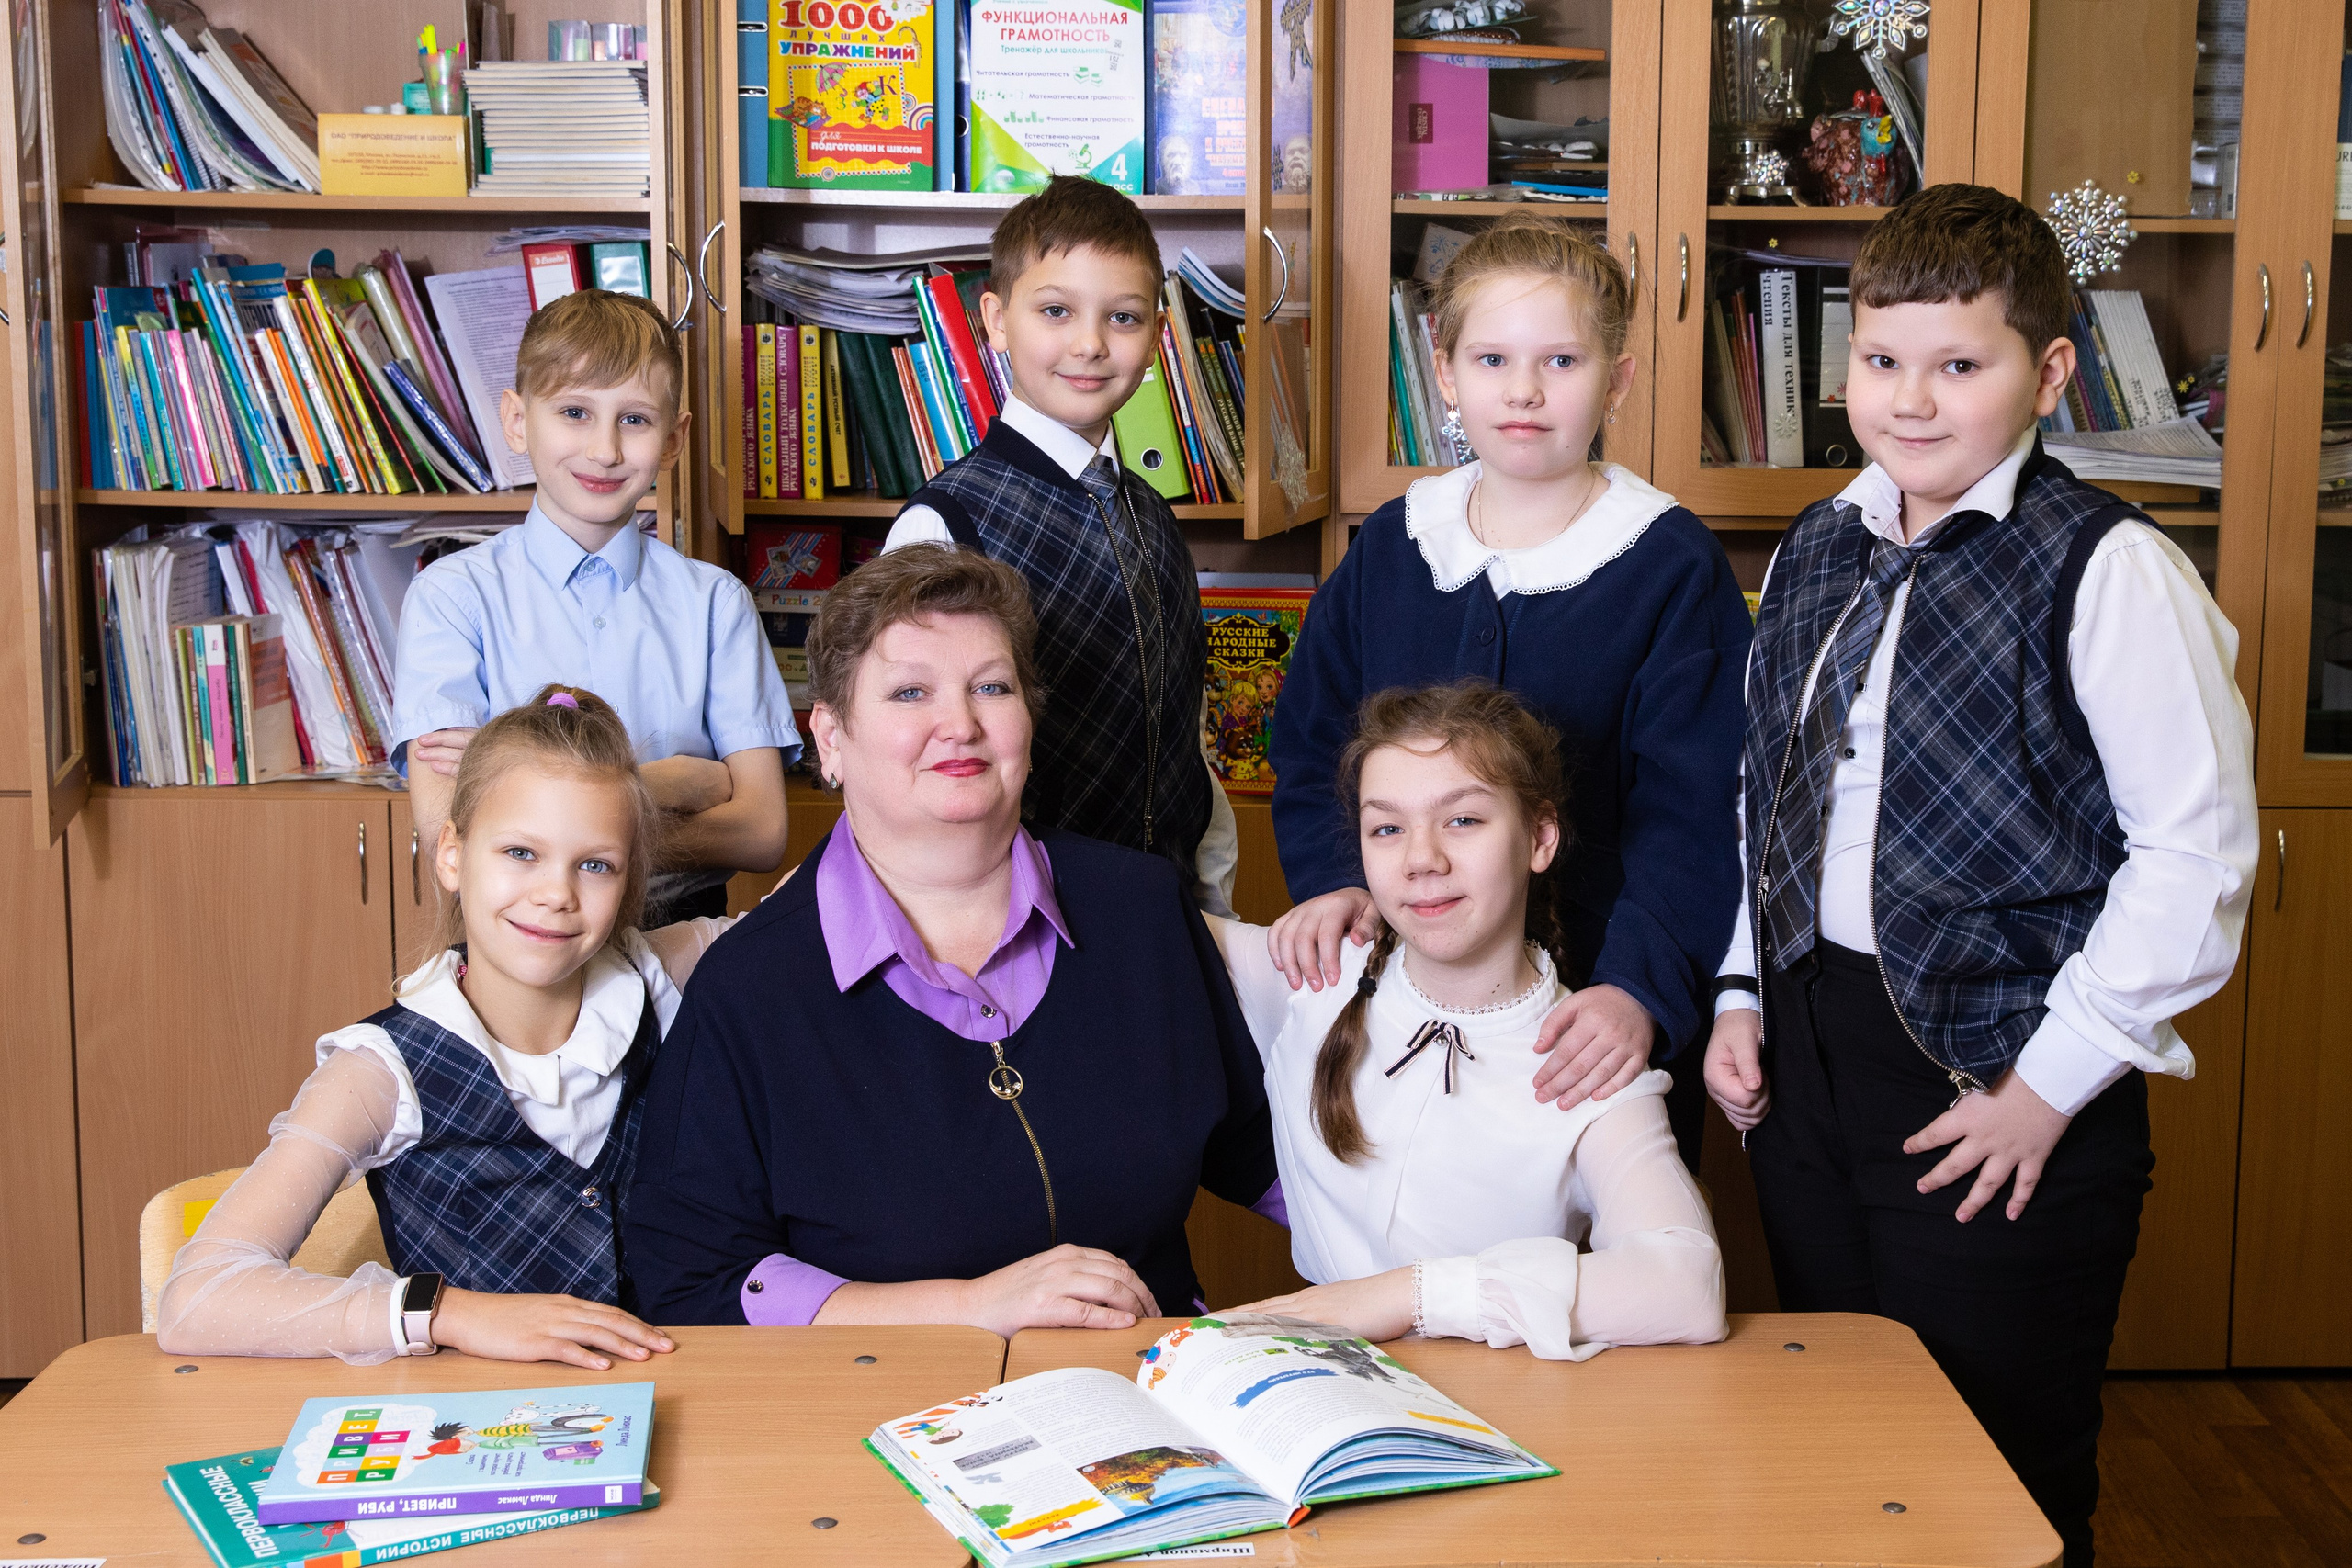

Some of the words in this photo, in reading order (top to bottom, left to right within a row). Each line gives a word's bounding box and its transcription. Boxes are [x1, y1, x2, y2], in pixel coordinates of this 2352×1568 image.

[780, 2, 895, 33] 1000
[981, 10, 1128, 25] ФУНКЦИОНАЛЬНАЯ
[1001, 28, 1110, 42] ГРАМОТНОСТЬ
[779, 41, 916, 61] УПРАЖНЕНИЙ
[1001, 45, 1043, 54] Тренажёр
[1045, 46, 1058, 54] для
[1091, 94, 1135, 102] грамотность
[1111, 153, 1128, 181] 4
[1763, 275, 1774, 325] чтения
[1781, 273, 1793, 328] Тексты
[778, 333, 788, 376] СЛОВАРЬ
[1781, 333, 1793, 357] для
[1784, 362, 1795, 417] техник
[779, 379, 789, 431] ТОЛКОВЫЙ
[1216, 398, 1232, 430] РУССКИЙ
[1226, 398, 1241, 430] РУССКИЙ
[762, 390, 773, 465] СЛОВАРЬ
[788, 407, 797, 440] ЯЗЫКА
[806, 392, 817, 467] СЛОВАРЬ
[746, 443, 756, 491] РУССКОГО
[780, 435, 790, 491] ШКОЛЬНЫЙ
[790, 443, 799, 491] РУССКОГО
[772, 594, 809, 606] Puzzle
[1207, 637, 1277, 649] НАРОДНЫЕ
[1212, 626, 1270, 637] РУССКИЕ
[1214, 648, 1266, 658] СКАЗКИ
[199, 1465, 280, 1559] ПЕРВОКЛАССНЫЕ
[357, 1500, 396, 1514] РУБИ
[399, 1497, 458, 1512] ПРИВЕТ,
[497, 1495, 528, 1506] Льюкас
[530, 1494, 558, 1505] Линда
[460, 1507, 599, 1544] ПЕРВОКЛАССНЫЕ
[376, 1535, 453, 1561] ИСТОРИИ
[1159, 1547, 1250, 1556] Ширманов
